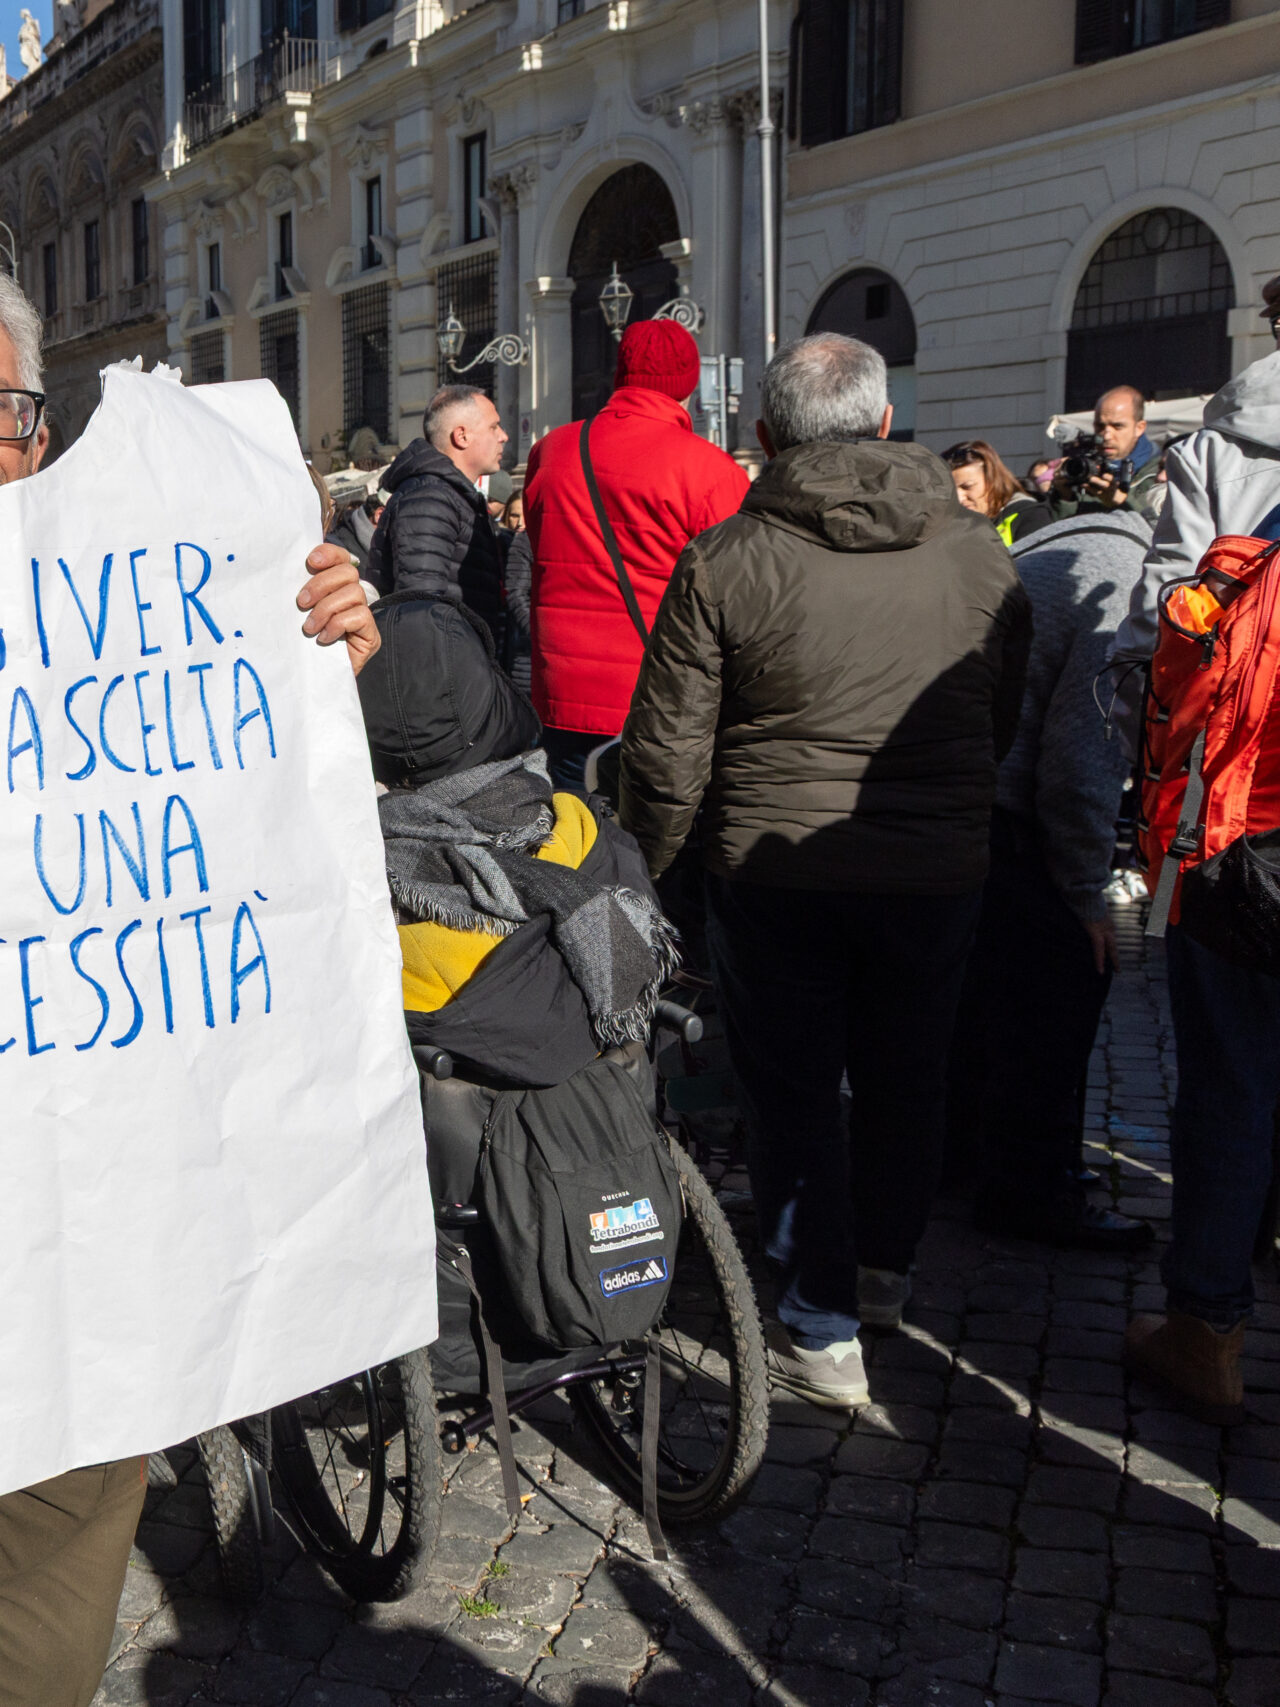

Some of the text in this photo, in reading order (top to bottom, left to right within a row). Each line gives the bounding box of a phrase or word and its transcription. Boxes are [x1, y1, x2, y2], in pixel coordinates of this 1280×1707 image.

[65, 657, 276, 781] SCELTA
[34, 794, 209, 916] UNA
[601, 1190, 630, 1201] QUECHUA
[592, 1214, 657, 1240] Tetrabondi
[604, 1270, 641, 1291] adidas
